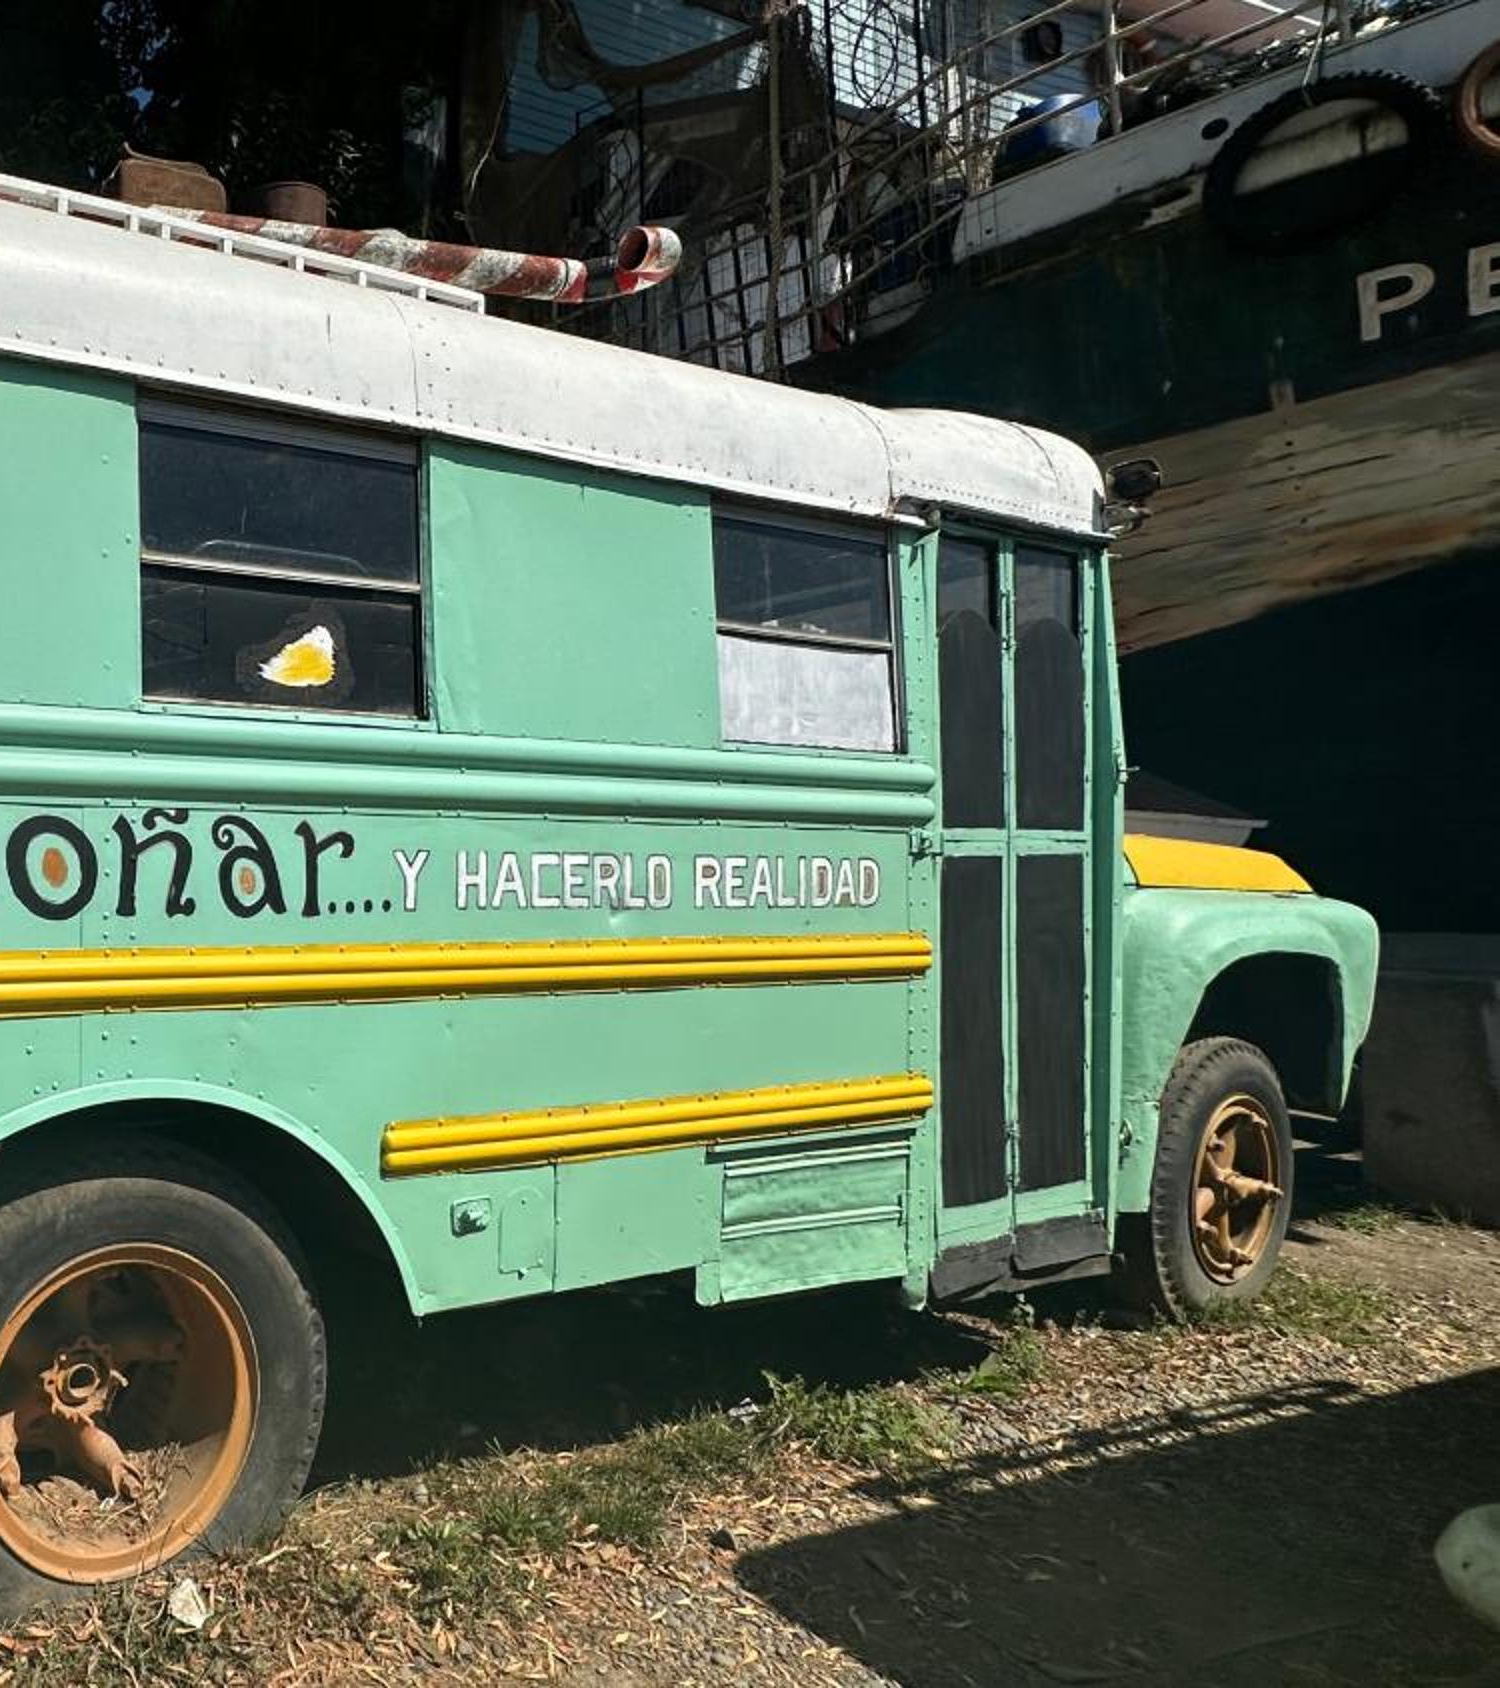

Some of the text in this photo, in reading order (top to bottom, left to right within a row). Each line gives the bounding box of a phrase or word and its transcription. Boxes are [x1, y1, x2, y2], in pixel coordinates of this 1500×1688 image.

[394, 849, 430, 912] Y
[456, 849, 674, 912] HACERLO
[694, 854, 881, 911] REALIDAD
